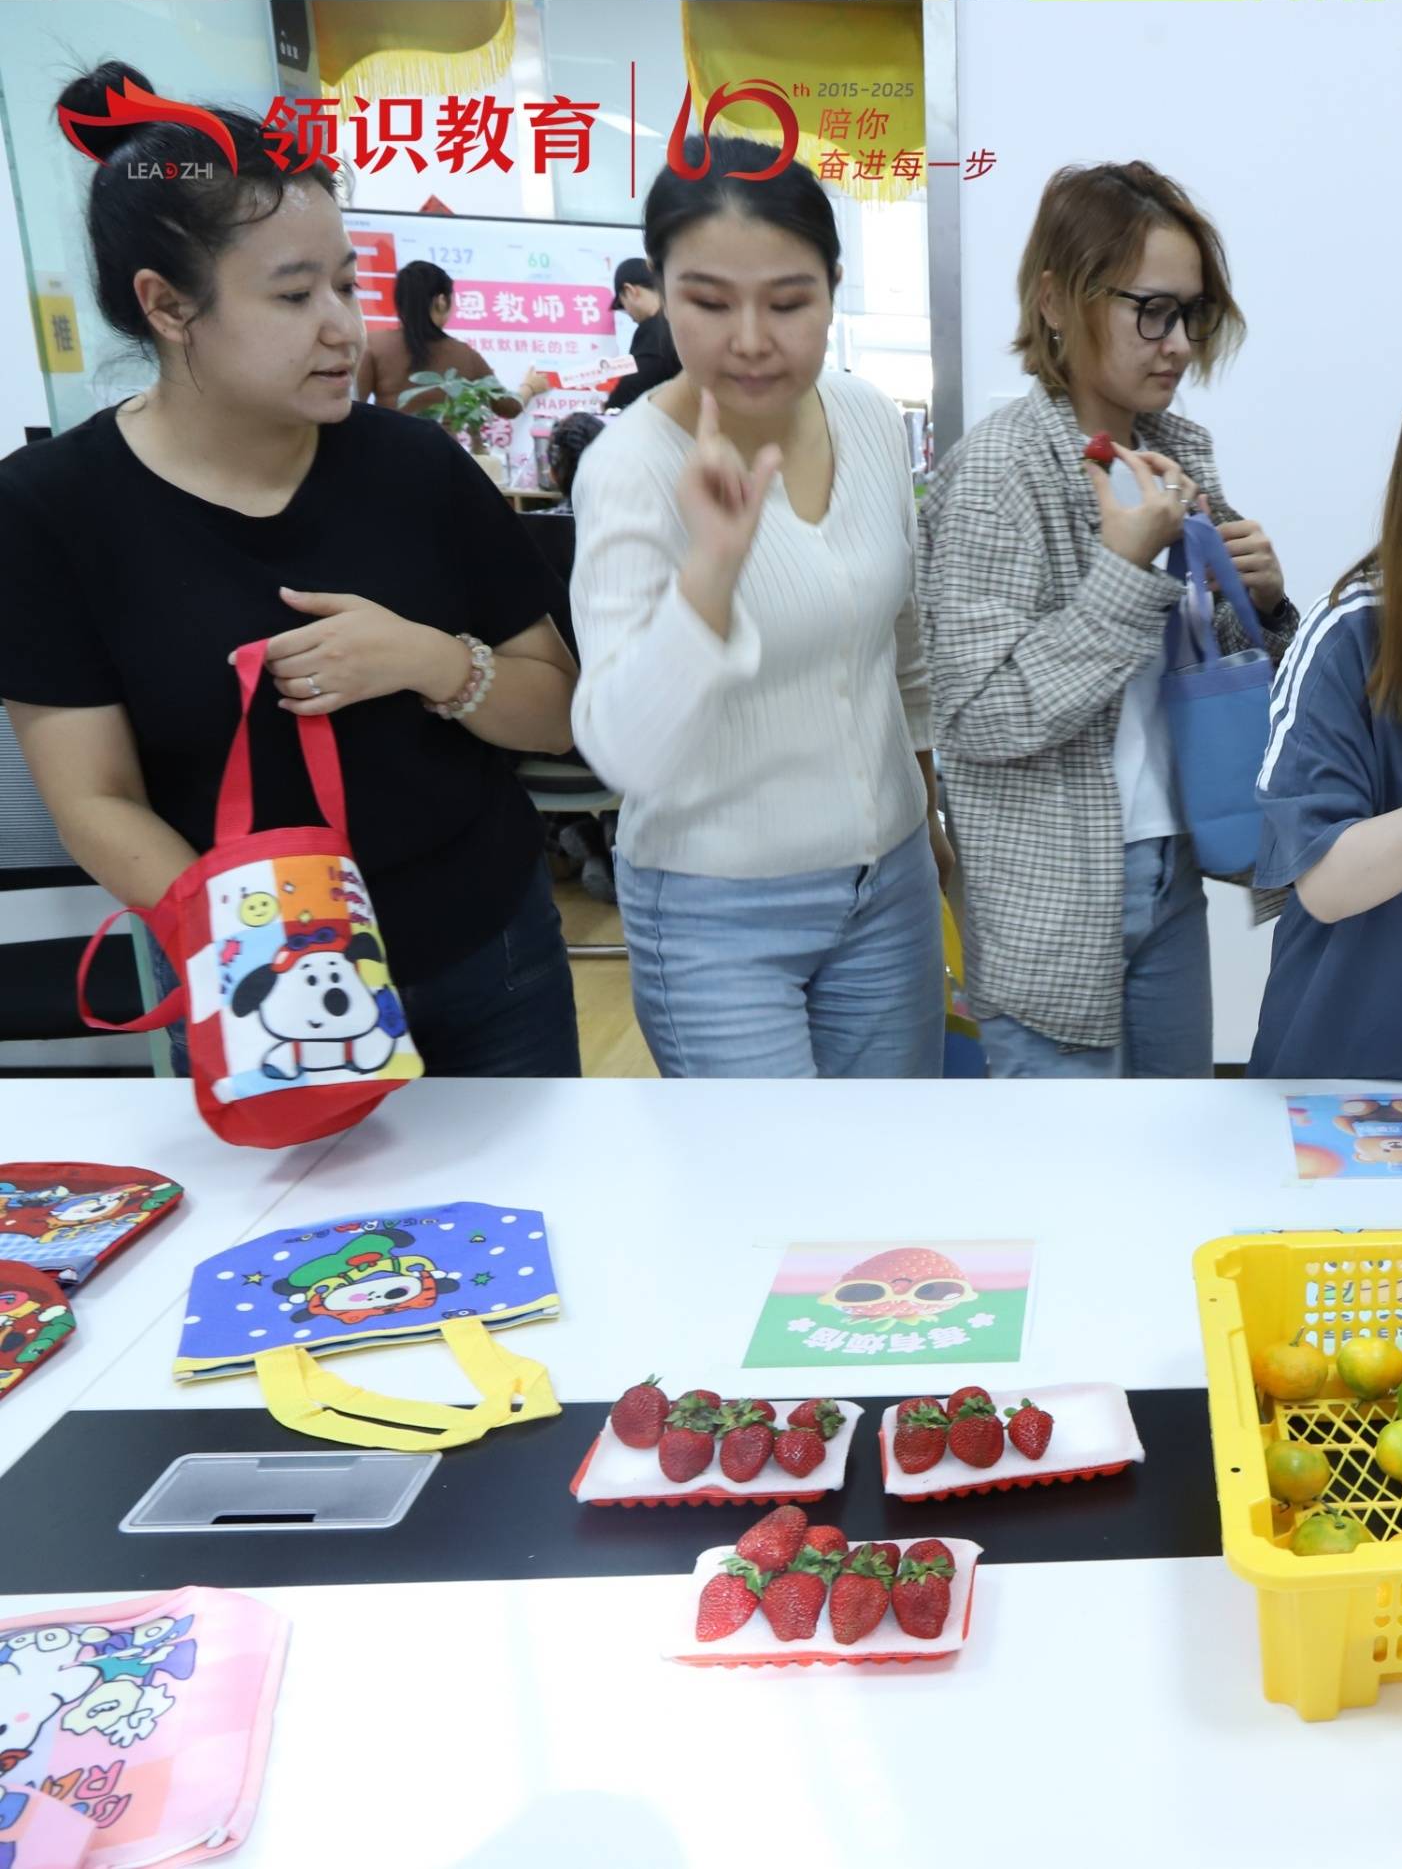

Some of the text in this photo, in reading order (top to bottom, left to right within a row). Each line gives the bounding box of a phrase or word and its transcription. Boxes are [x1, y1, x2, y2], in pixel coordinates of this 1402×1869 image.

[428, 246, 473, 265] 1237
[528, 251, 551, 268] 60
[455, 290, 600, 325] 恩教师节
